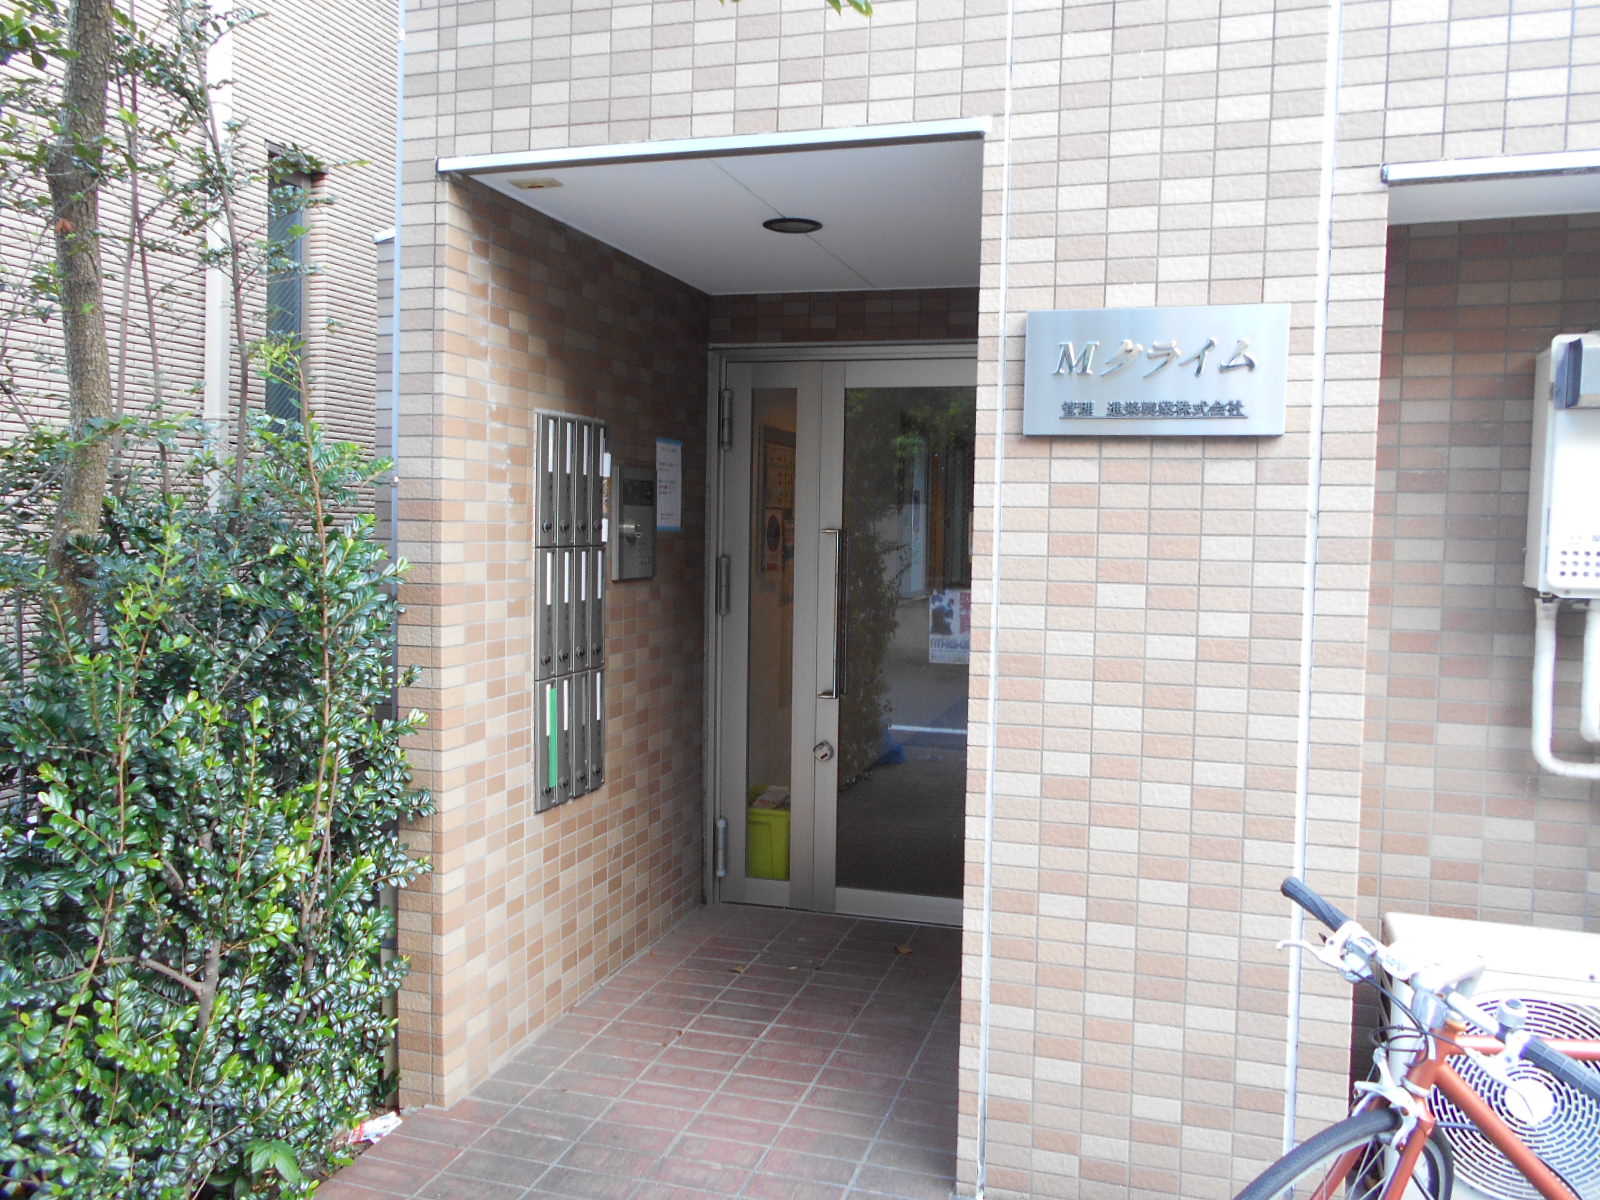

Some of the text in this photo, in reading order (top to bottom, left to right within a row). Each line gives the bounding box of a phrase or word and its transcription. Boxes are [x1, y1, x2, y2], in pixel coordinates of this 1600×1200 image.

[1052, 338, 1256, 377] Mクライム
[1061, 400, 1095, 417] 管理
